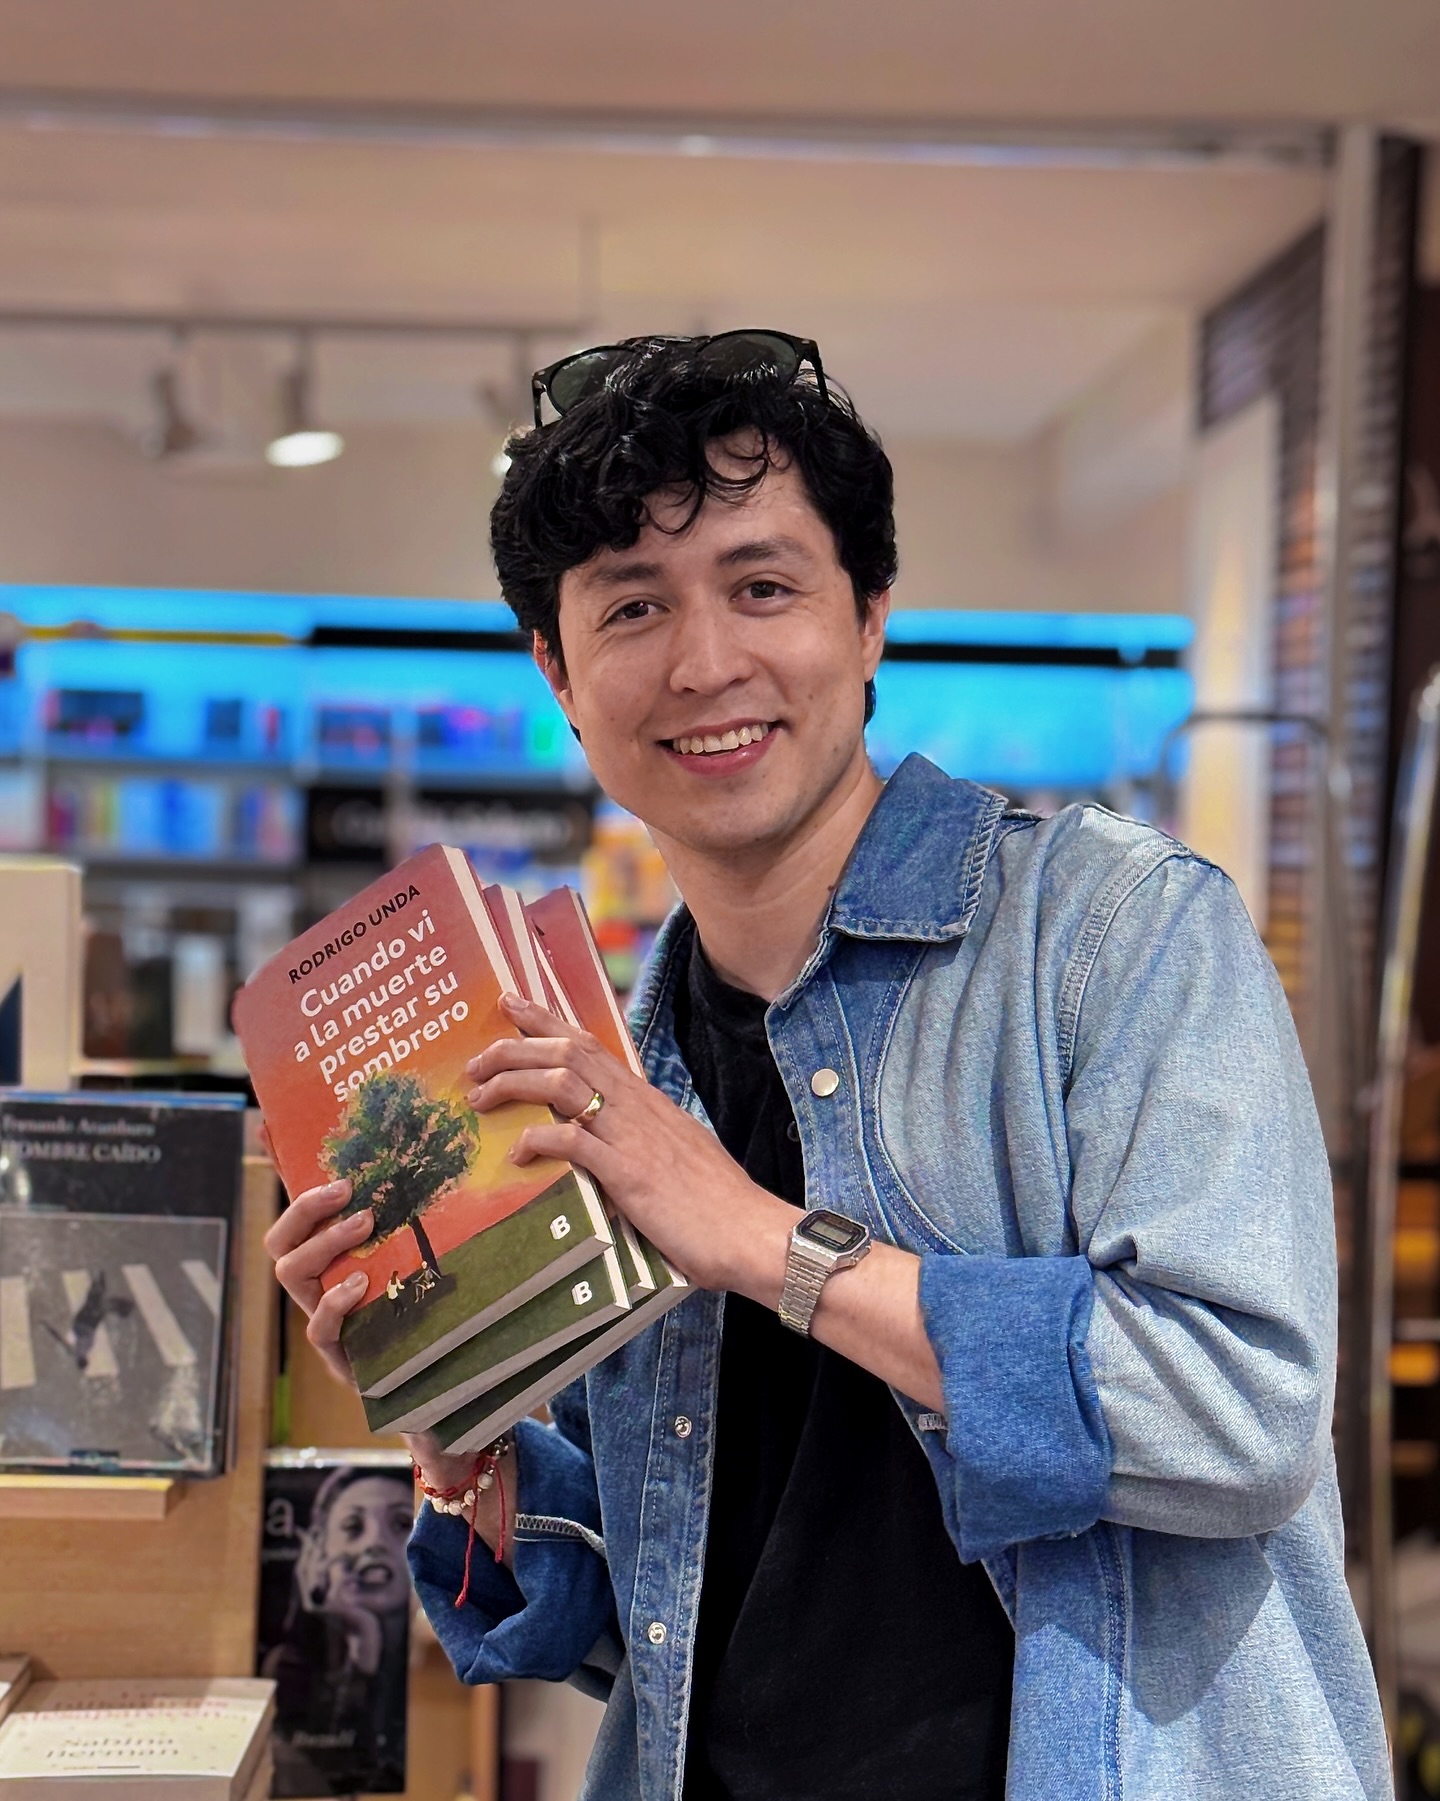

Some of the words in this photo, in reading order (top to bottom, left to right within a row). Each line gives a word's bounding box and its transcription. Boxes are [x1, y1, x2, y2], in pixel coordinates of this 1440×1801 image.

[288, 922, 367, 985] RODRIGO
[368, 885, 421, 926] UNDA
[300, 938, 406, 1017] Cuando
[407, 909, 436, 942] vi
[294, 1040, 311, 1062] a
[309, 1019, 340, 1047] la
[341, 946, 448, 1027] muerte
[319, 996, 419, 1084] prestar
[424, 971, 459, 1006] su
[333, 1001, 469, 1102] sombrero
[549, 1214, 571, 1240] B
[571, 1280, 593, 1306] B
